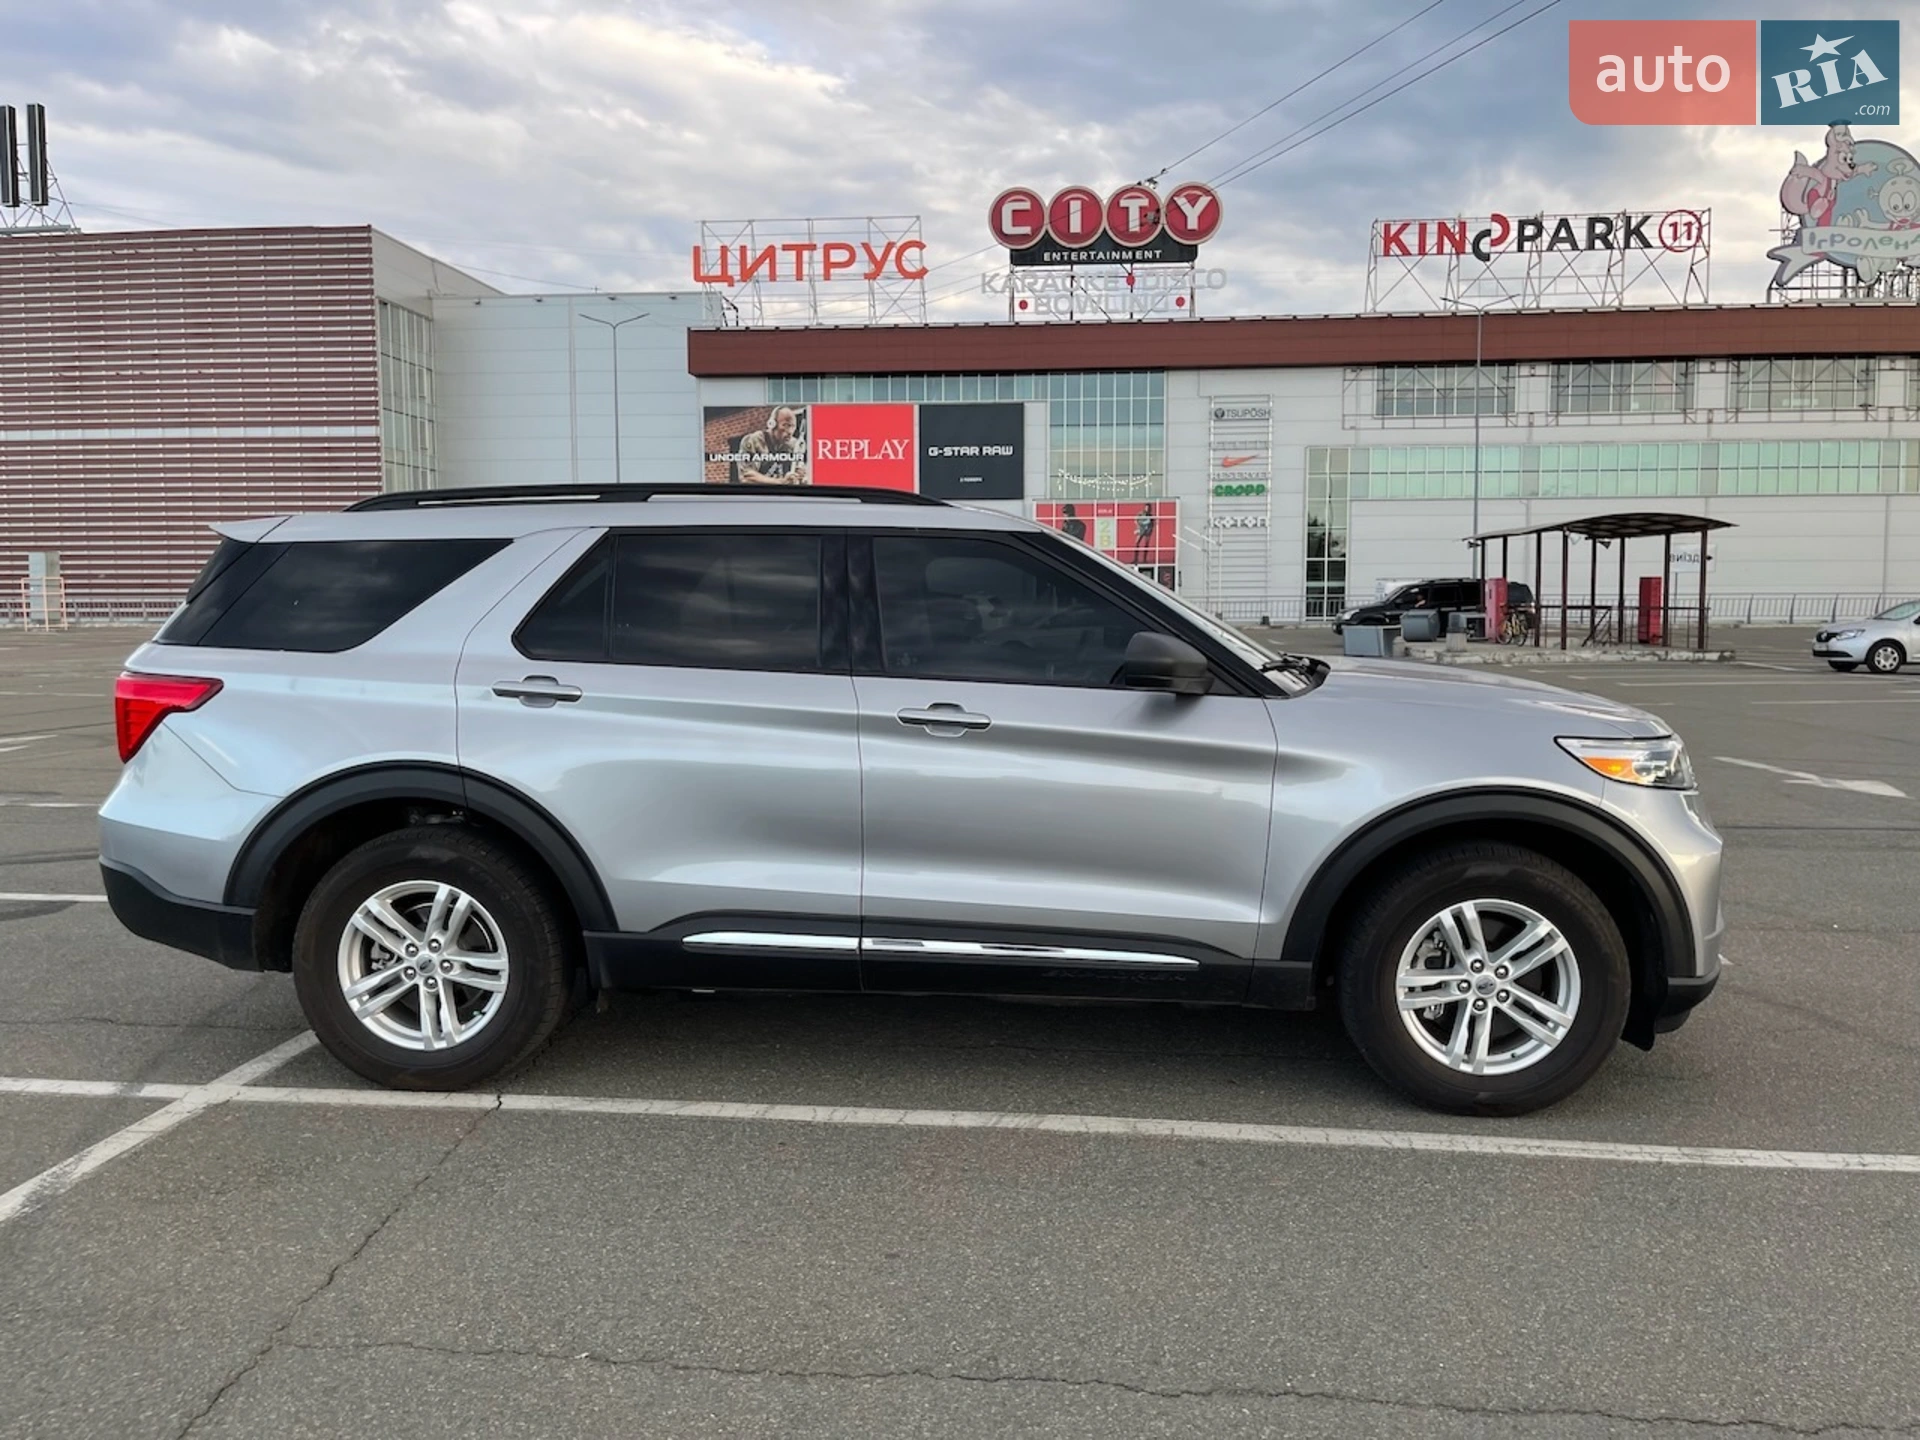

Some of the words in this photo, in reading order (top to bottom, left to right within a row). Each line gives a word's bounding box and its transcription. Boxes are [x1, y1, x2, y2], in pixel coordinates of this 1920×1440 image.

[1001, 195, 1214, 235] CITY
[692, 239, 930, 288] ЦИТРУС
[1043, 249, 1163, 262] ENTERTAINMENT
[981, 270, 1122, 295] KARAOKE
[1141, 267, 1227, 291] DISCO
[1034, 293, 1169, 316] BOWLING
[709, 453, 750, 462] UNDER
[752, 452, 804, 462] ARMOUR
[816, 438, 911, 461] REPLAY
[928, 445, 980, 457] G-STAR
[982, 445, 1014, 456] RAW
[1214, 483, 1266, 497] CROPP
